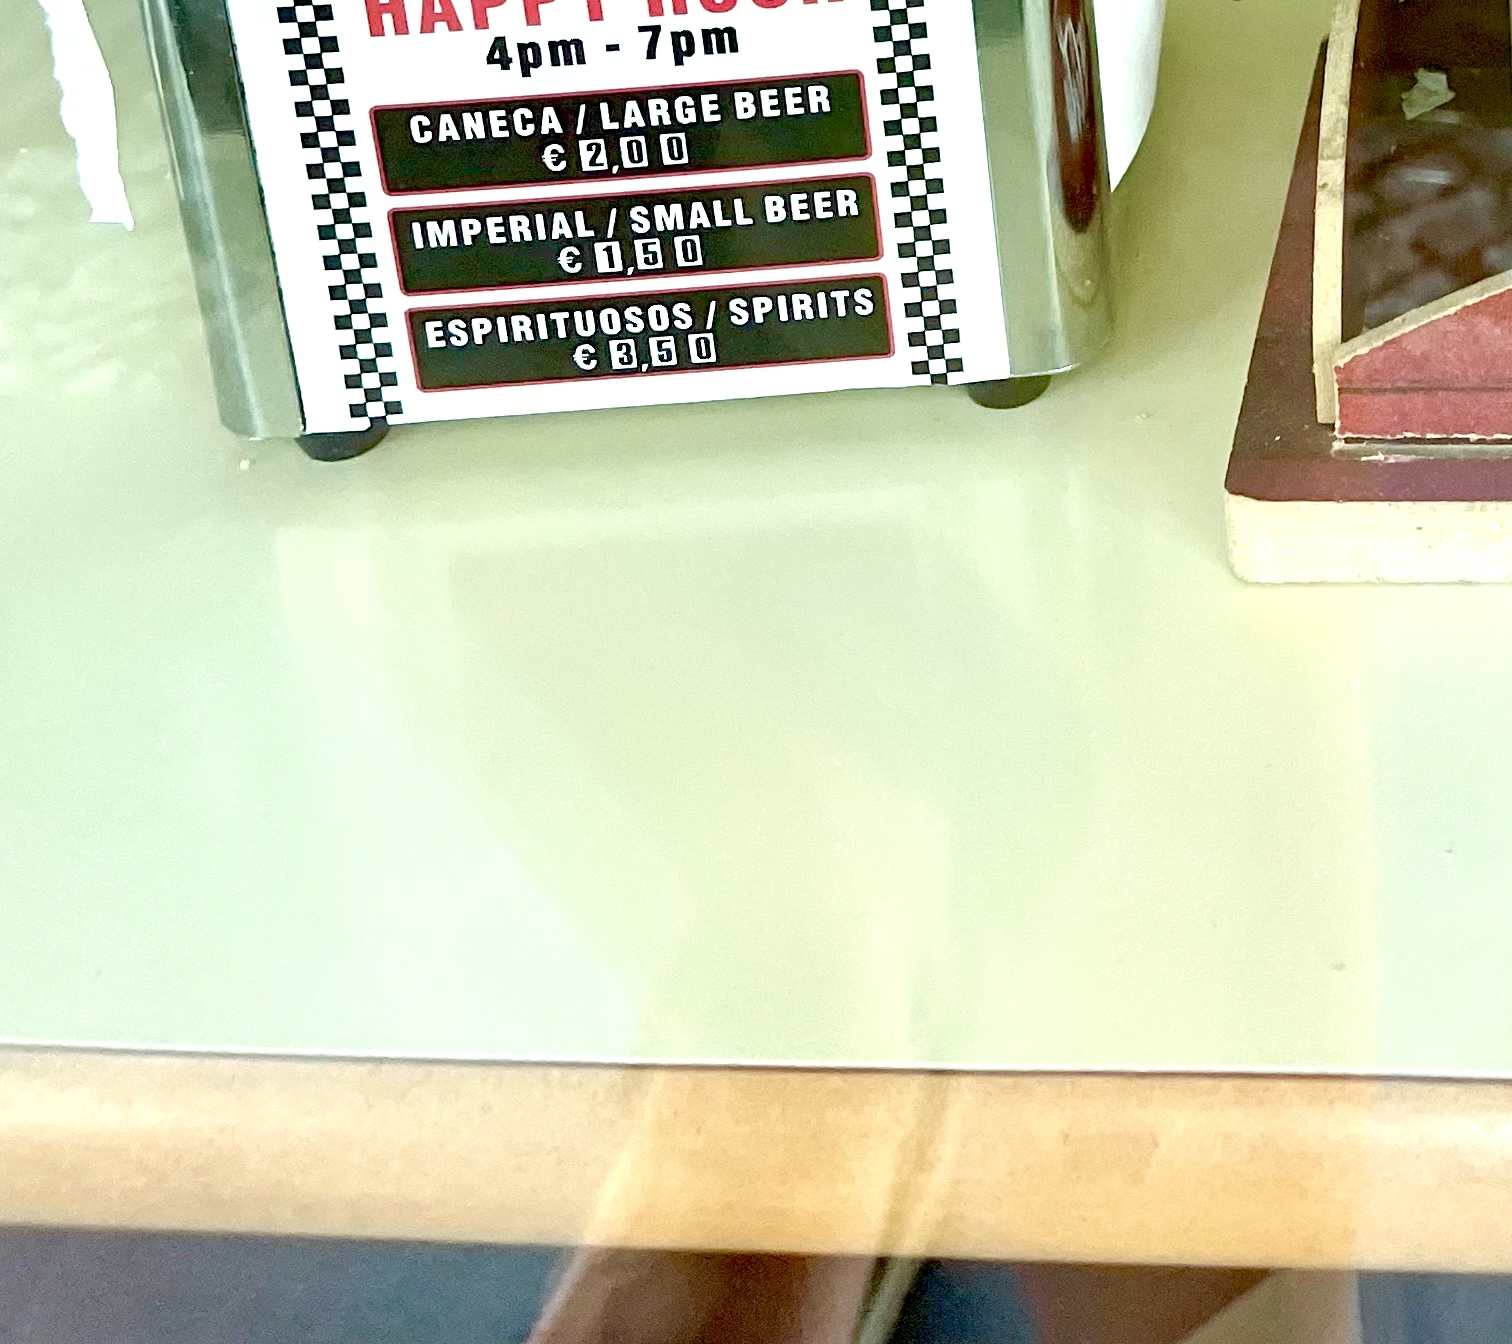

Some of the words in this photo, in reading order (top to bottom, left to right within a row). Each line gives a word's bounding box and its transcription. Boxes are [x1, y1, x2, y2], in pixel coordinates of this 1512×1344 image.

[486, 33, 587, 77] 4pm
[638, 23, 739, 66] 7pm
[409, 107, 564, 145] CANECA
[601, 91, 722, 132] LARGE
[735, 84, 831, 121] BEER
[411, 209, 595, 250] IMPERIAL
[630, 196, 754, 235] SMALL
[764, 188, 860, 225] BEER
[423, 302, 694, 349] ESPIRITUOSOS
[730, 287, 875, 327] SPIRITS
